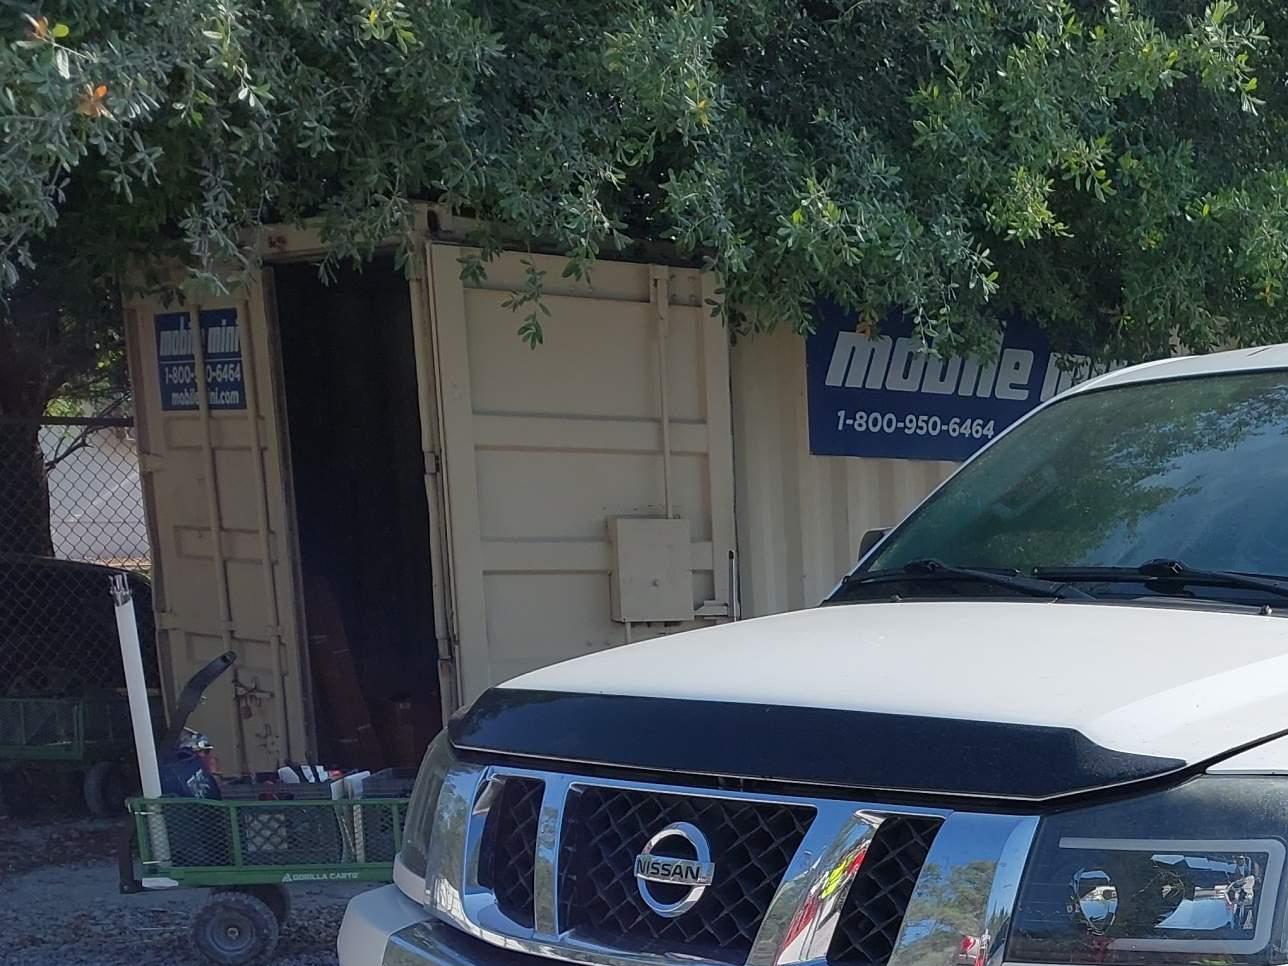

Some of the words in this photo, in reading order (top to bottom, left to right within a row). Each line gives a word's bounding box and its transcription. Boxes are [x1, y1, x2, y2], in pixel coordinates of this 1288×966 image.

[165, 363, 241, 384] 1-800-0-6464
[837, 410, 995, 440] 1-800-950-6464
[636, 859, 700, 880] NISSAN
